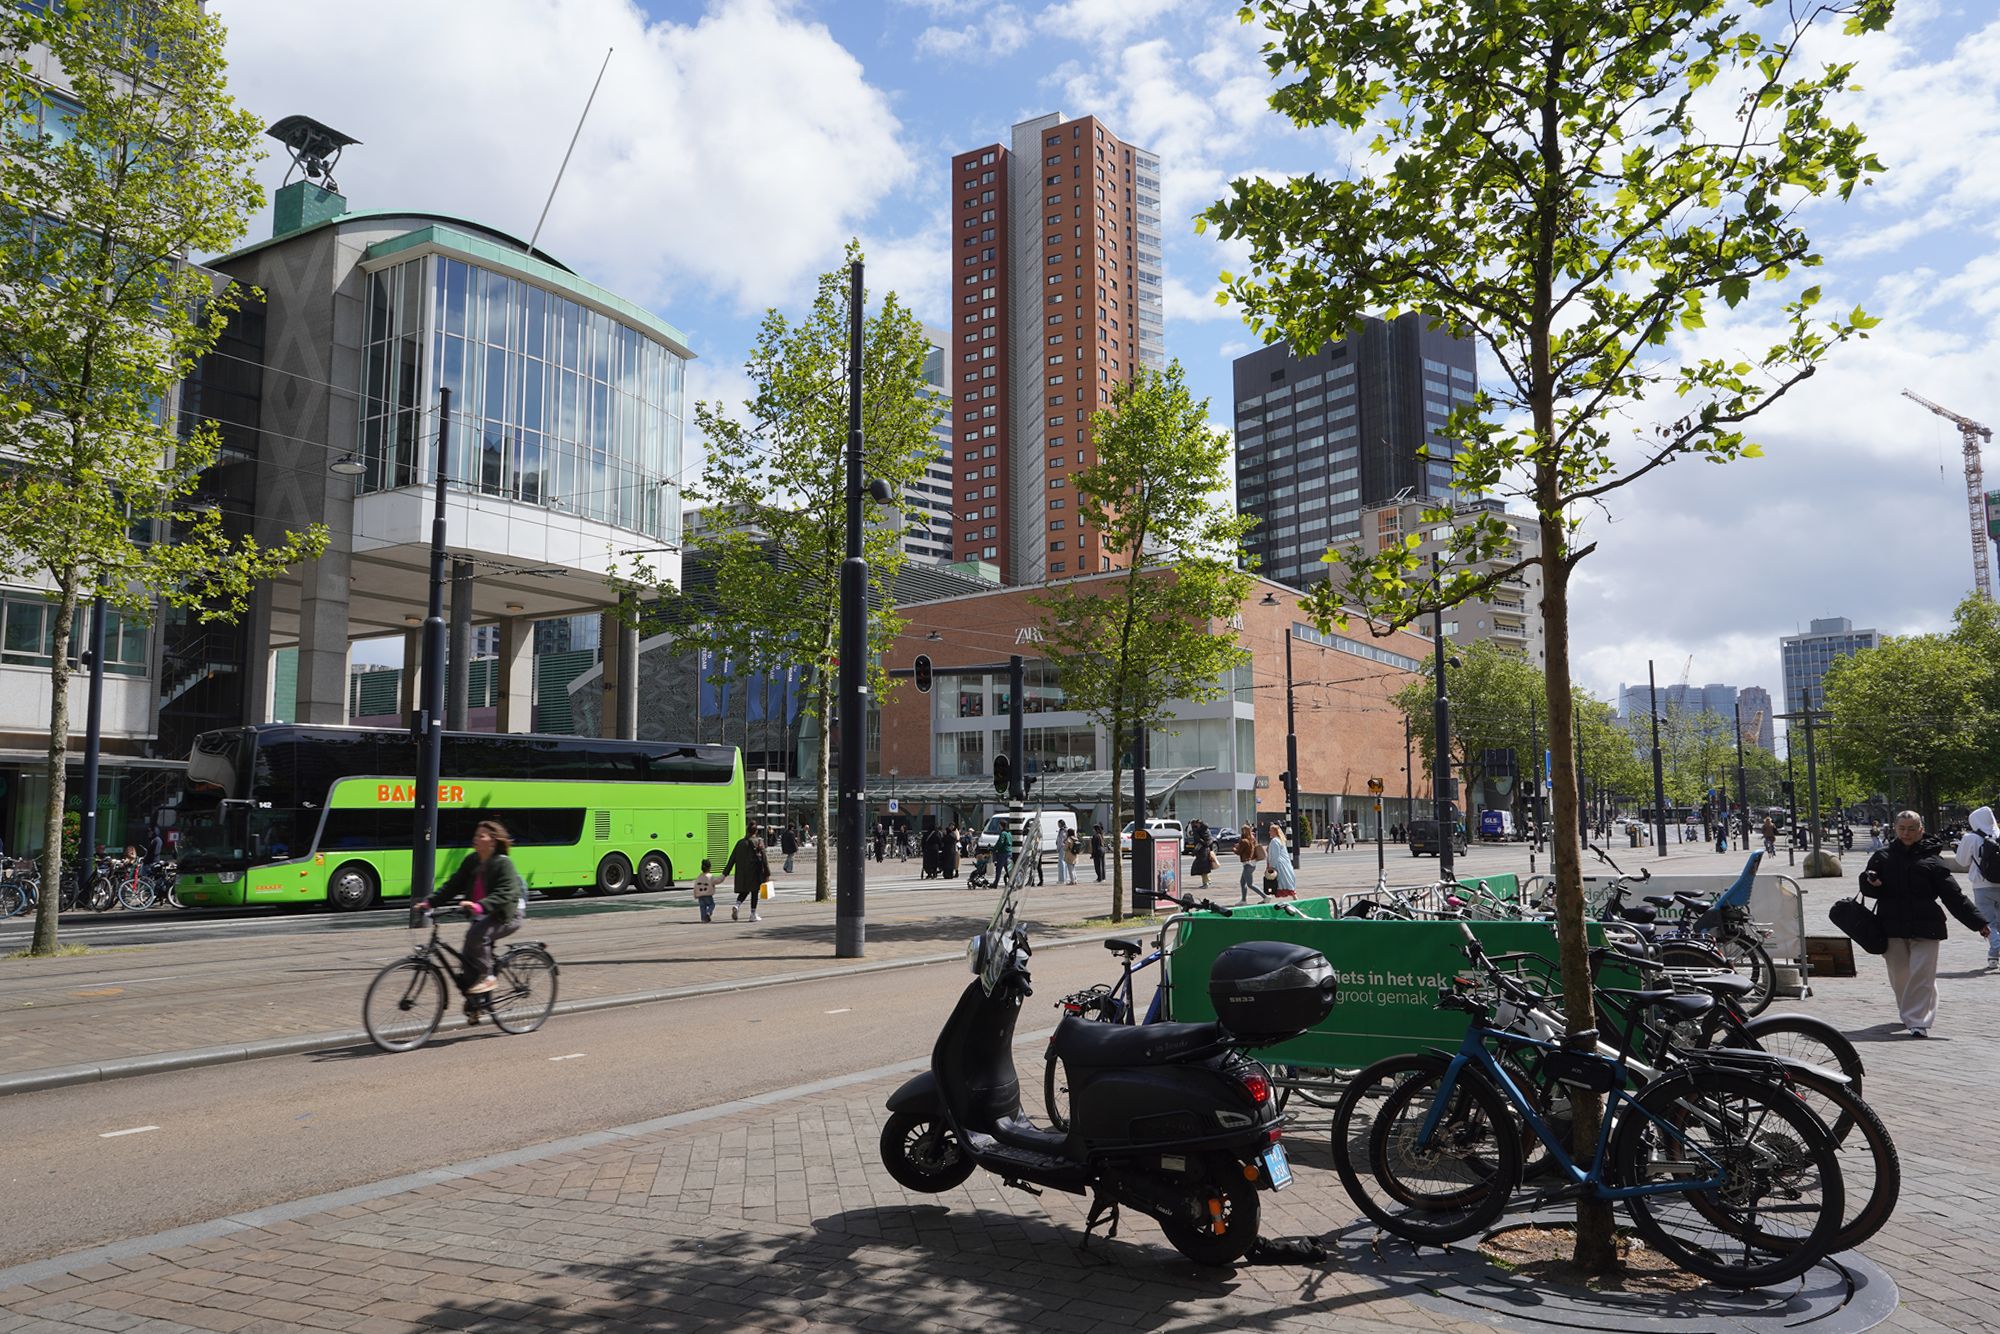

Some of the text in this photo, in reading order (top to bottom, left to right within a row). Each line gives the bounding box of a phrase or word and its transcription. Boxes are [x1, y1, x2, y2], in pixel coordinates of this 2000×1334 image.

[378, 784, 465, 803] BAKER
[1368, 970, 1383, 985] in
[1387, 970, 1414, 986] het
[1417, 973, 1447, 988] vak
[1335, 989, 1428, 1006] groot gemak
